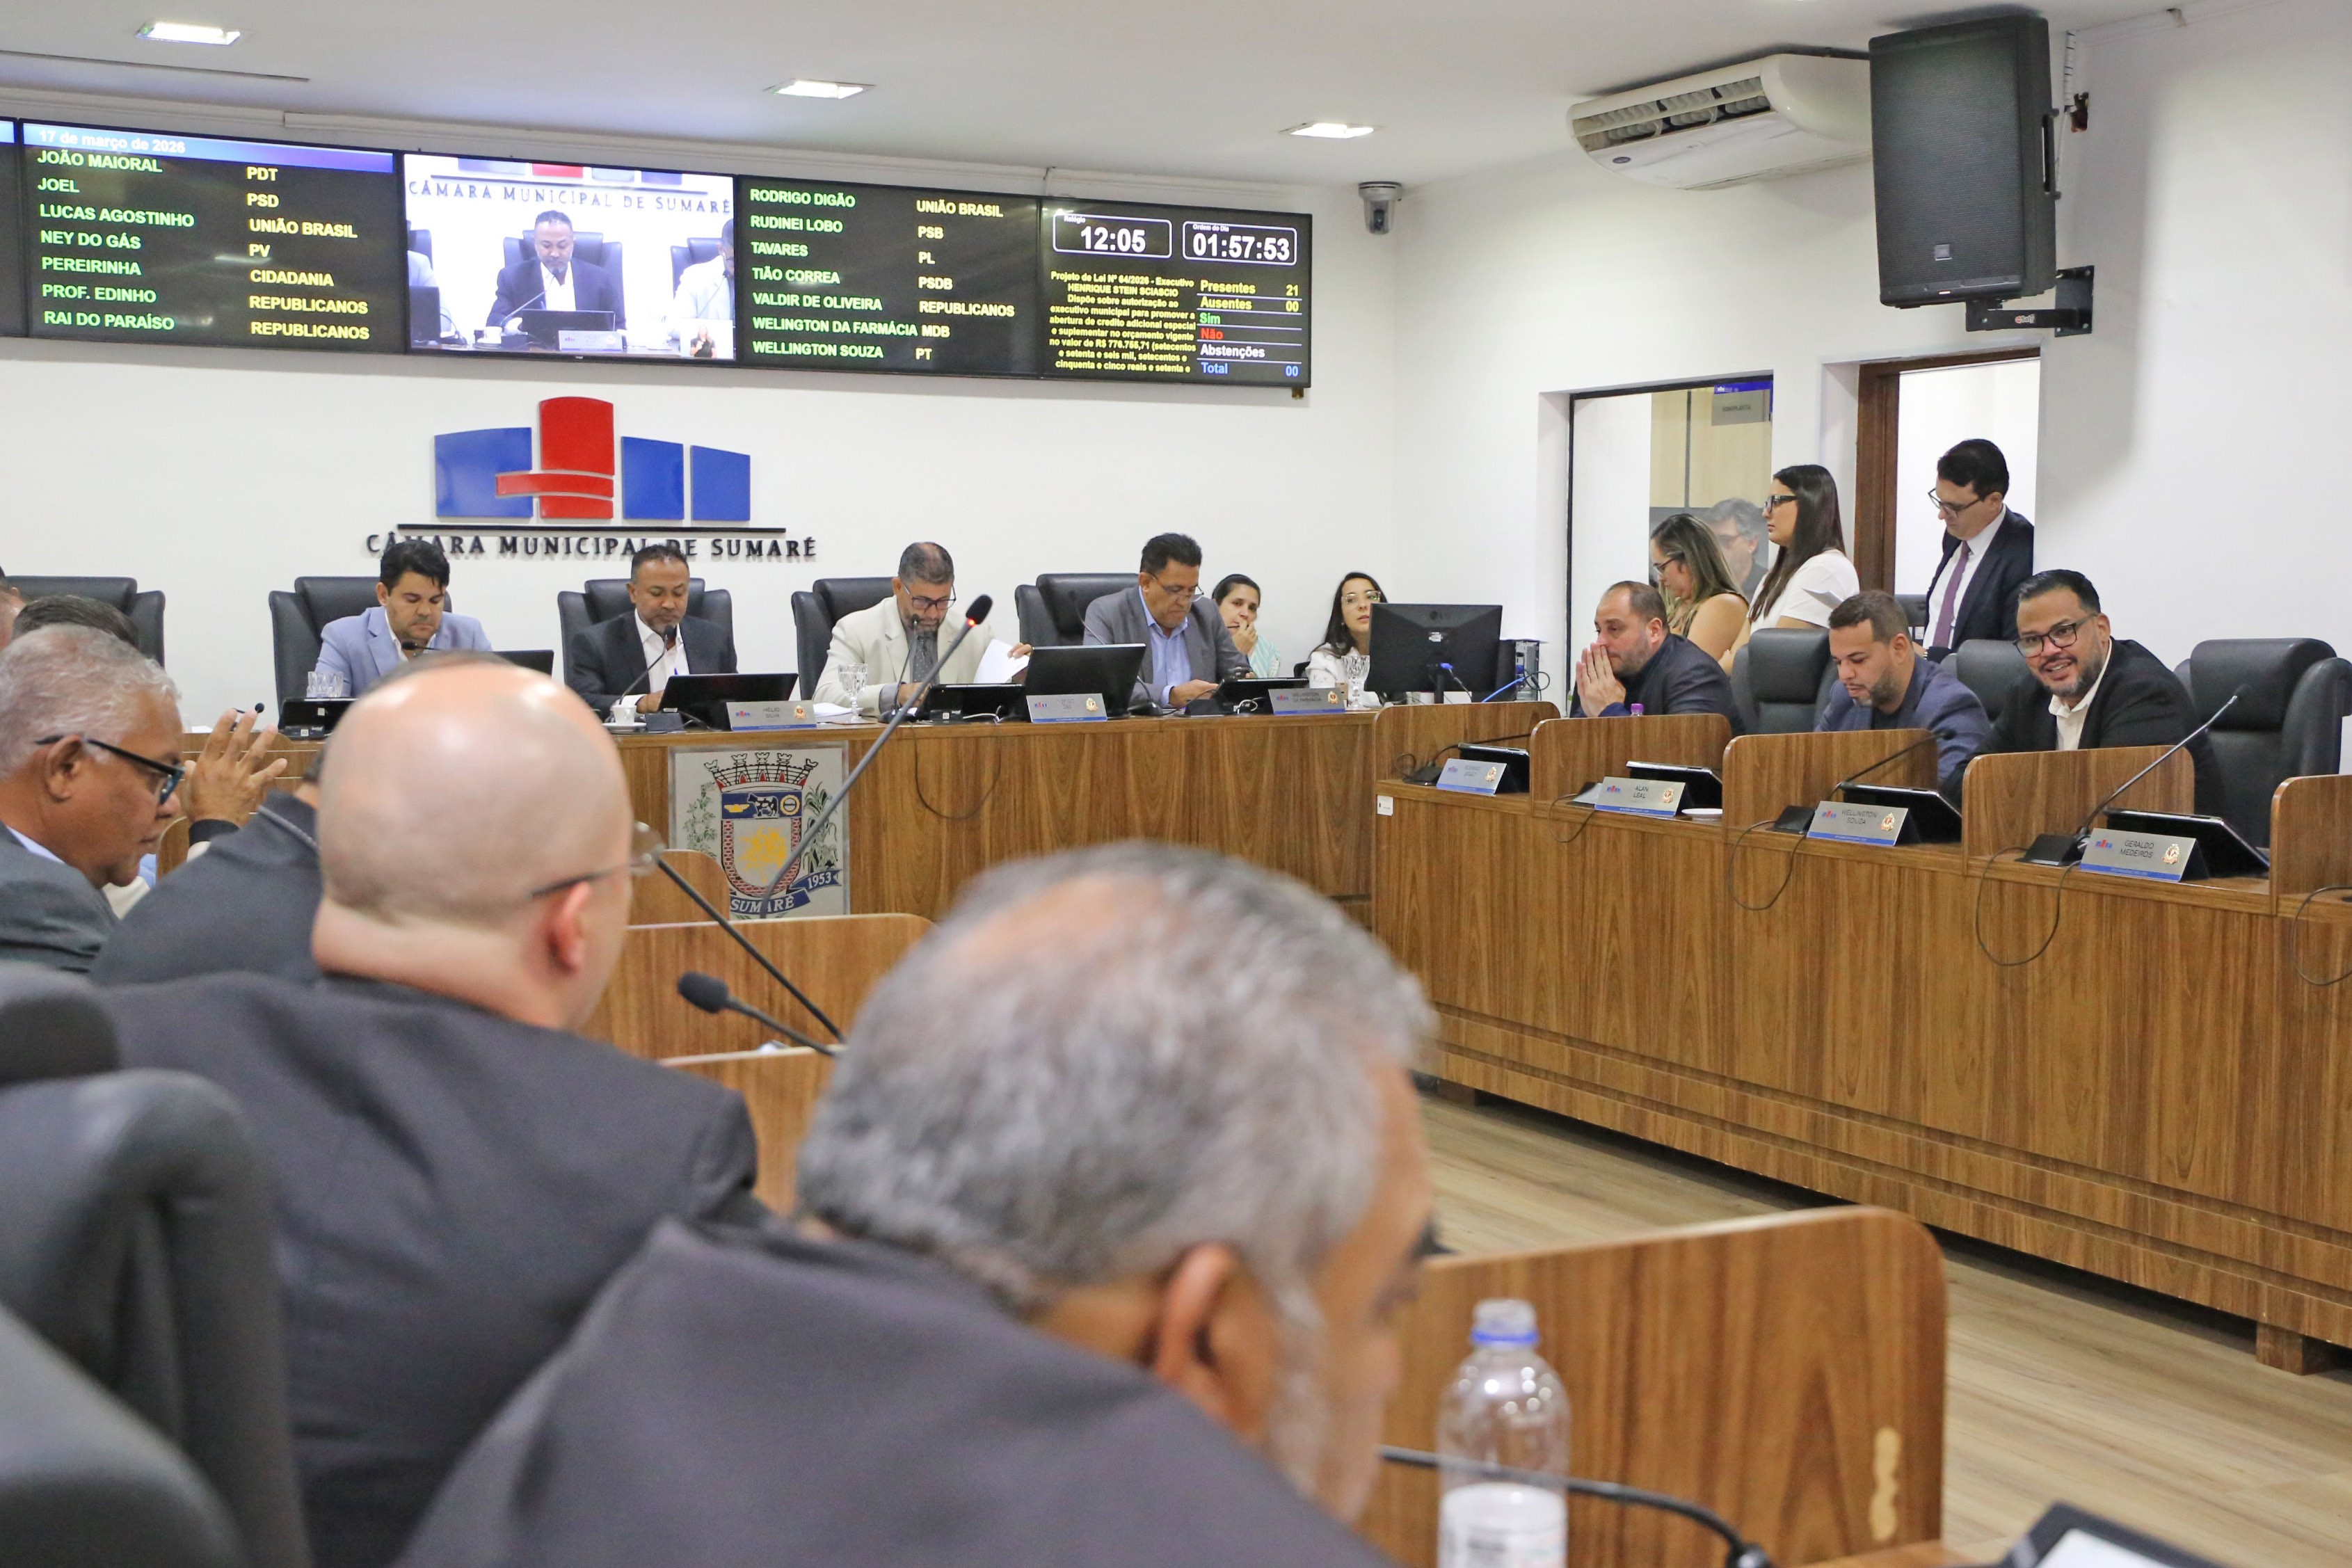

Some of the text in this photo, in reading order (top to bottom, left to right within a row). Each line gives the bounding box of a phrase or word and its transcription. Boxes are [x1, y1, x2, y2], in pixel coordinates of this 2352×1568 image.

[40, 130, 186, 154] 17 de março de 2026
[37, 150, 163, 173] JOÃO MAIORAL
[247, 166, 278, 182] PDT
[38, 177, 80, 193] JOEL
[247, 193, 279, 209] PSD
[409, 179, 731, 214] CÂMARA MUNICIPAL DE SUMARÉ
[750, 189, 856, 208] RODRIGO DIGÃO
[40, 204, 195, 227] LUCAS AGOSTINHO
[916, 199, 1003, 218] UNIÃO BRASIL
[249, 216, 358, 239] UNIÃO BRASIL
[750, 215, 843, 233] RUDINEI LOBO
[1192, 223, 1211, 232] Ordem
[40, 230, 141, 250] NEY DO GÁS
[918, 226, 943, 240] PSB
[1080, 225, 1146, 253] 12:05
[249, 244, 271, 257] PV
[751, 241, 808, 257] TAVARES
[1192, 232, 1290, 262] 01:57:53
[918, 251, 935, 264] PL
[42, 257, 141, 275] PEREIRINHA
[250, 269, 334, 287] CIDADANIA
[752, 265, 840, 285] TIÃO CORREA
[918, 276, 953, 290] PSDB
[1050, 271, 1080, 282] Projeto
[1081, 273, 1091, 282] de
[1094, 273, 1106, 282] Lei
[1155, 277, 1194, 287] Executivo
[42, 283, 157, 303] PROF. EDINHO
[1068, 283, 1112, 294] HENRIQUE
[1113, 285, 1137, 295] STEIN
[1200, 280, 1299, 296] Presentes 21
[249, 296, 369, 314] REPUBLICANOS
[753, 292, 883, 311] VALDIR DE OLIVEIRA
[1097, 296, 1119, 305] sobre
[1201, 296, 1299, 312] Ausentes 00
[919, 301, 1014, 317] REPUBLICANOS
[1050, 305, 1089, 314] executivo
[1091, 307, 1130, 318] municipal
[1131, 310, 1149, 318] para
[1151, 310, 1188, 320] promover
[44, 310, 175, 330] RAI DO PARAÍSO
[1049, 316, 1083, 325] abertura
[1085, 317, 1095, 326] de
[1126, 319, 1162, 328] adicional
[1163, 321, 1196, 331] especial
[1199, 312, 1221, 325] Sim
[251, 322, 370, 340] REPUBLICANOS
[753, 317, 918, 337] WELINGTON DA FARMÁCIA
[922, 325, 950, 338] MDB
[1058, 327, 1108, 337] suplementar
[1165, 333, 1194, 343] vigente
[1200, 327, 1224, 340] Não
[753, 341, 883, 359] WELLINGTON SOUZA
[1062, 337, 1082, 346] valor
[1083, 338, 1094, 347] de
[915, 348, 932, 360] PT
[1066, 350, 1095, 358] setenta
[1103, 351, 1120, 360] seis
[1138, 353, 1181, 362] setecentos
[1201, 344, 1265, 359] Abstenções
[1055, 360, 1095, 371] cinquenta
[1103, 362, 1126, 371] cinco
[1127, 362, 1147, 371] reais
[1155, 364, 1184, 373] setenta
[1201, 362, 1299, 378] Total 00
[366, 531, 486, 554] CÂARA
[710, 536, 817, 557] SUMARÉ
[1841, 809, 1877, 818] WELLINGTON
[2125, 840, 2154, 849] GERALDO
[2120, 848, 2154, 858] MEDEIROS
[808, 872, 832, 890] 1953
